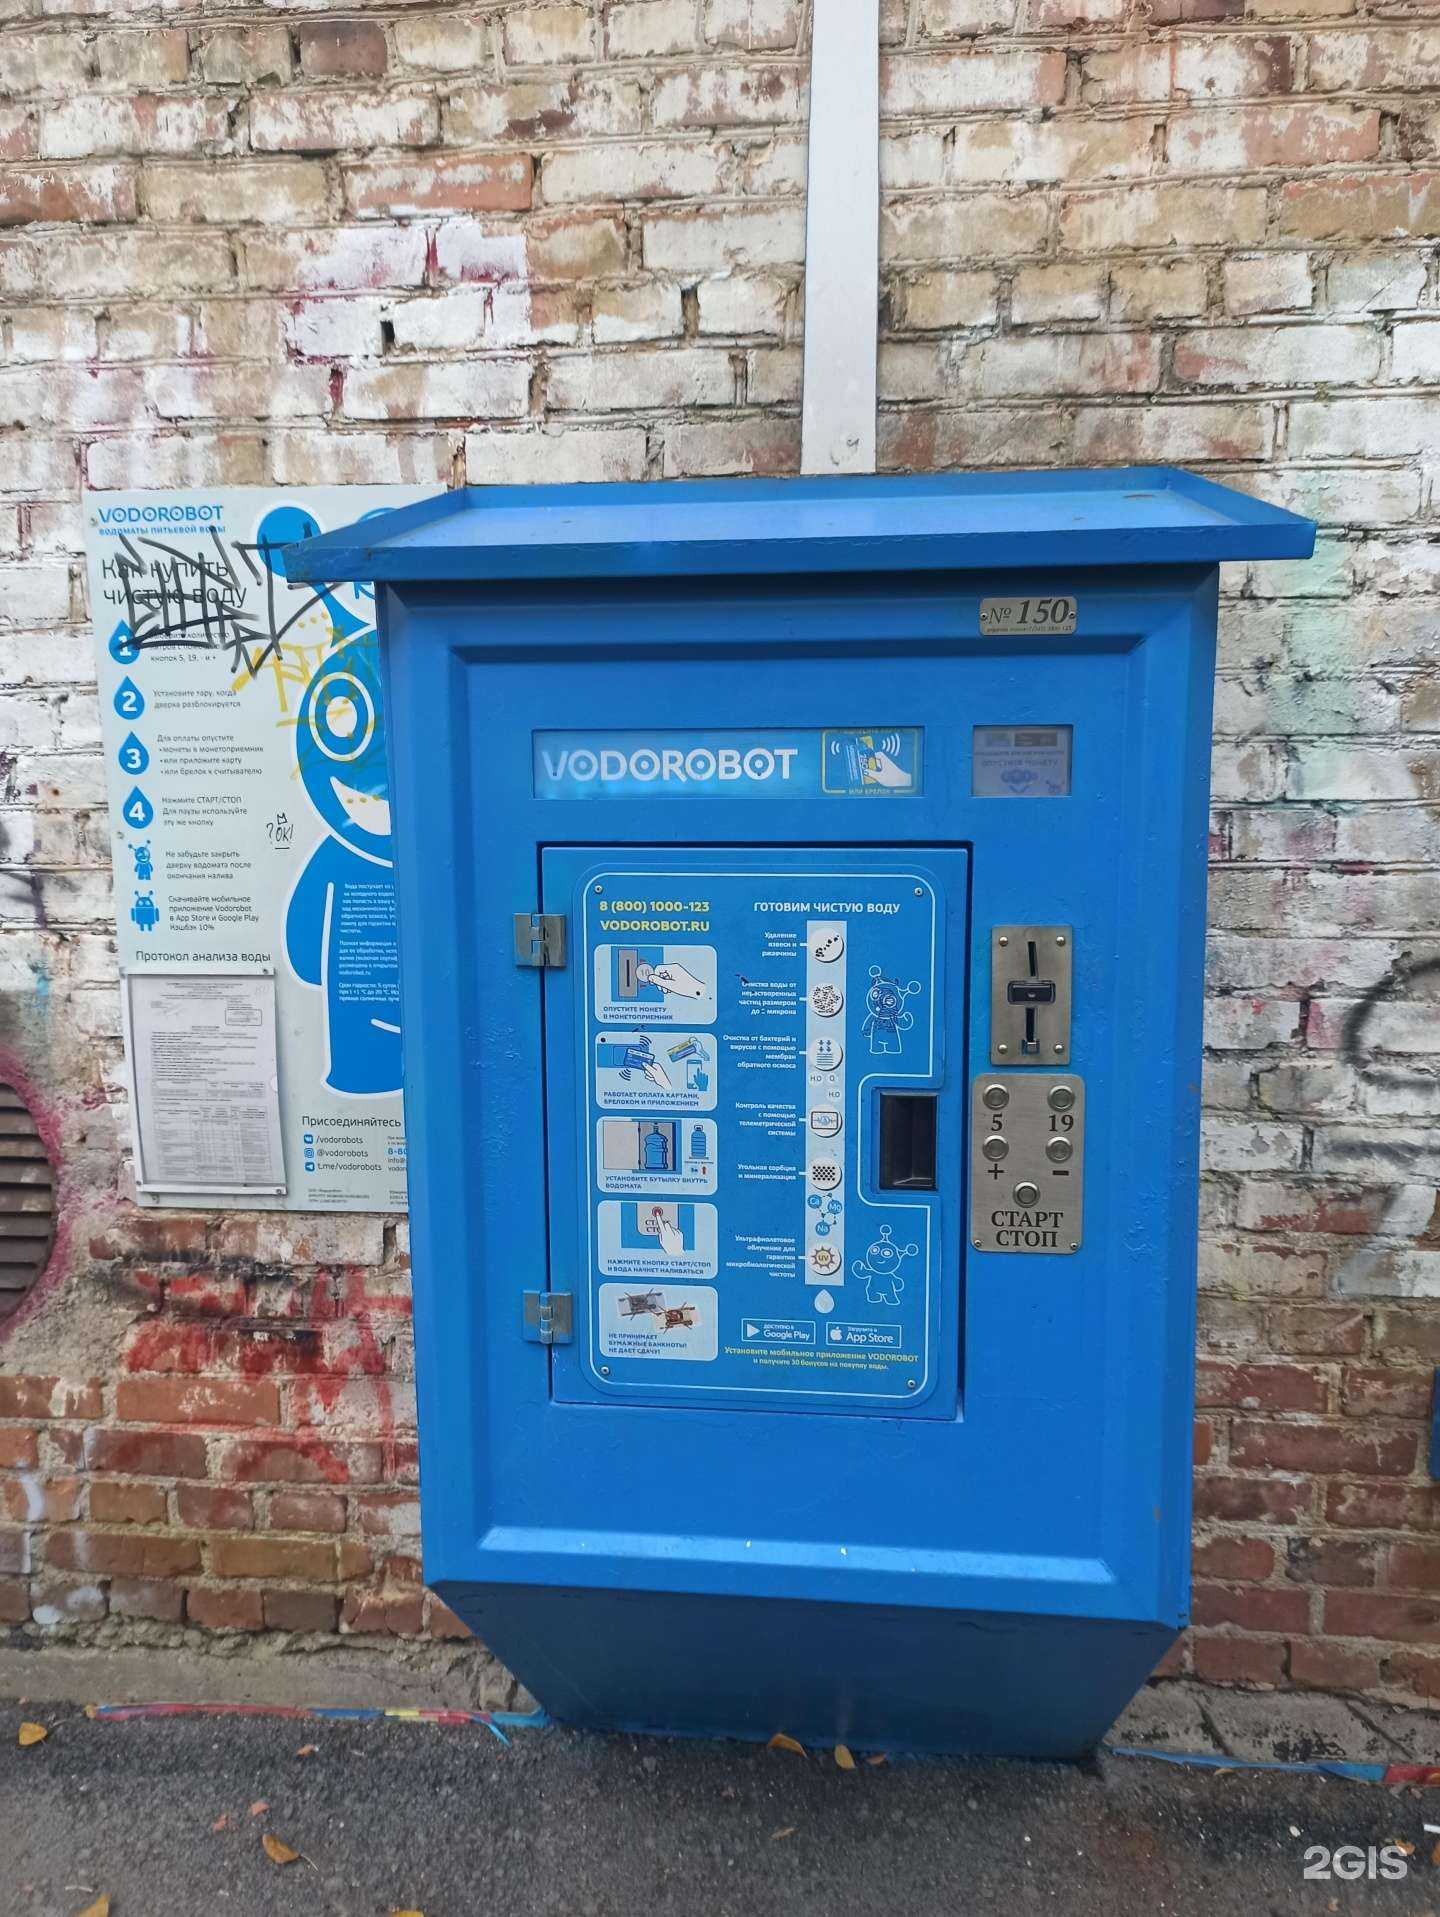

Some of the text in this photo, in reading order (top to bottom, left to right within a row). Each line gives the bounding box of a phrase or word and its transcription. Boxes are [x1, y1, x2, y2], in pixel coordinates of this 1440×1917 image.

[99, 505, 223, 523] VODOROBOT
[193, 588, 246, 607] воду
[1017, 599, 1069, 624] 150
[119, 635, 132, 656] 1
[123, 691, 137, 711] 2
[126, 748, 141, 768] 3
[542, 748, 797, 782] VODOROBOT
[129, 801, 145, 821] 4
[163, 808, 176, 816] Для
[600, 901, 709, 914] 8 (800) 1000-123
[754, 902, 900, 914] ГОТОВИМ ЧИСТУЮ ВОДУ
[600, 920, 709, 931] VODOROBOT.RU
[765, 932, 797, 940] Удаление
[136, 951, 271, 962] Протокол анализа воды
[760, 1034, 791, 1042] бактерий
[302, 1116, 401, 1127] Присоединяйтесь
[991, 1114, 1074, 1132] 5 19
[316, 1136, 363, 1144] /vodorobots
[317, 1149, 368, 1157] @vodorobots
[991, 1210, 1064, 1228] СТАРТ
[996, 1230, 1058, 1247] СТОП
[763, 1330, 810, 1341] Google Play
[846, 1332, 894, 1343] App Store
[724, 1346, 768, 1355] Установите
[816, 1352, 866, 1361] приложение
[868, 1353, 919, 1363] VODOROBOT
[800, 1359, 828, 1367] бонусов
